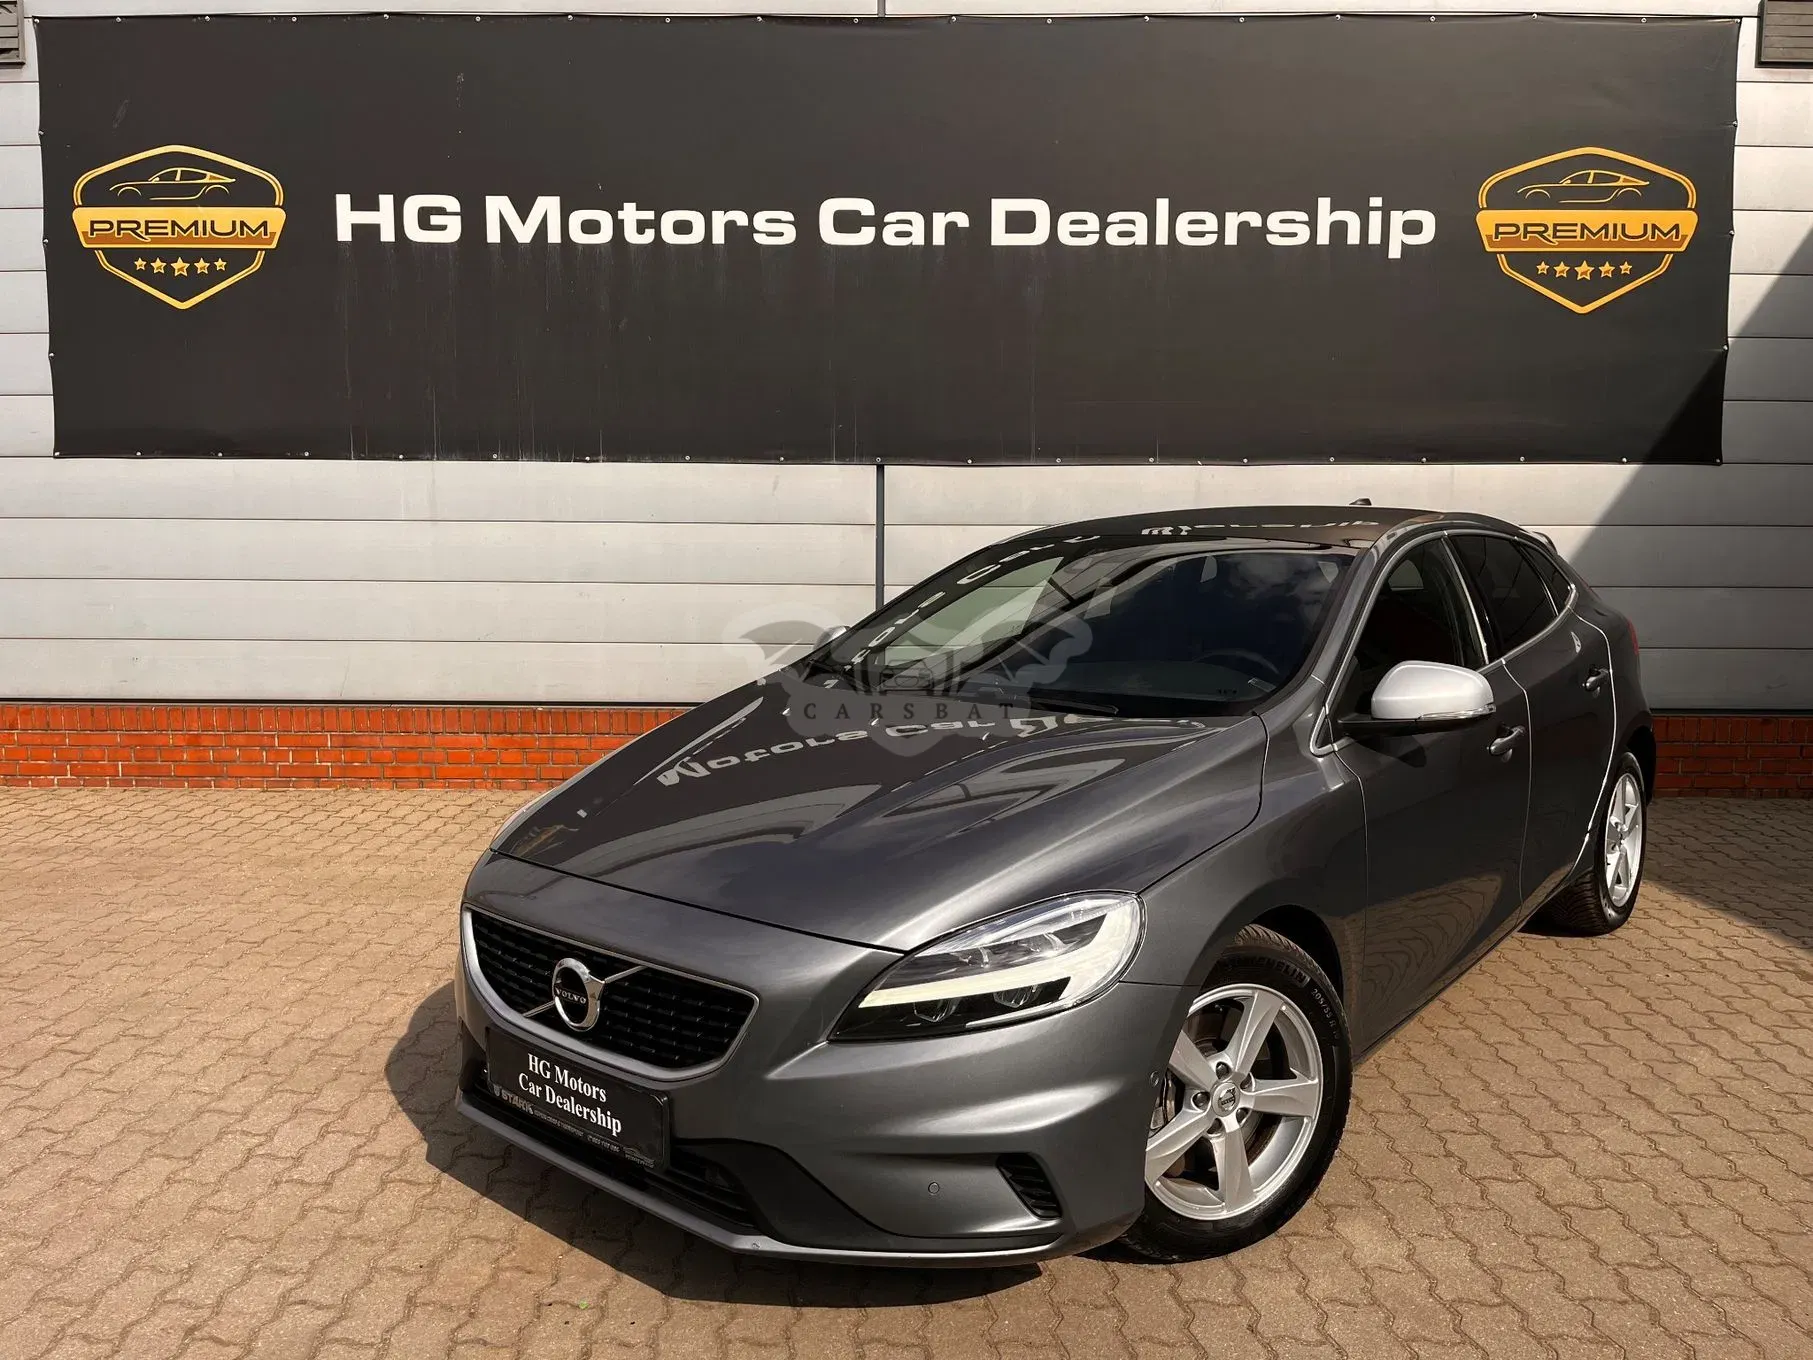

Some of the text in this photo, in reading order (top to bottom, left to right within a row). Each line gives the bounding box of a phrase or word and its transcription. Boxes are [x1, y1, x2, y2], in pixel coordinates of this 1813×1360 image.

[88, 219, 269, 242] PREMIUM
[336, 193, 1436, 259] HG Motors Car Dealership
[1493, 222, 1681, 245] PREMIUM
[555, 988, 587, 1005] VOLVO
[527, 1053, 607, 1103] HG Motors
[518, 1072, 542, 1099] Car
[545, 1084, 622, 1137] Dealership
